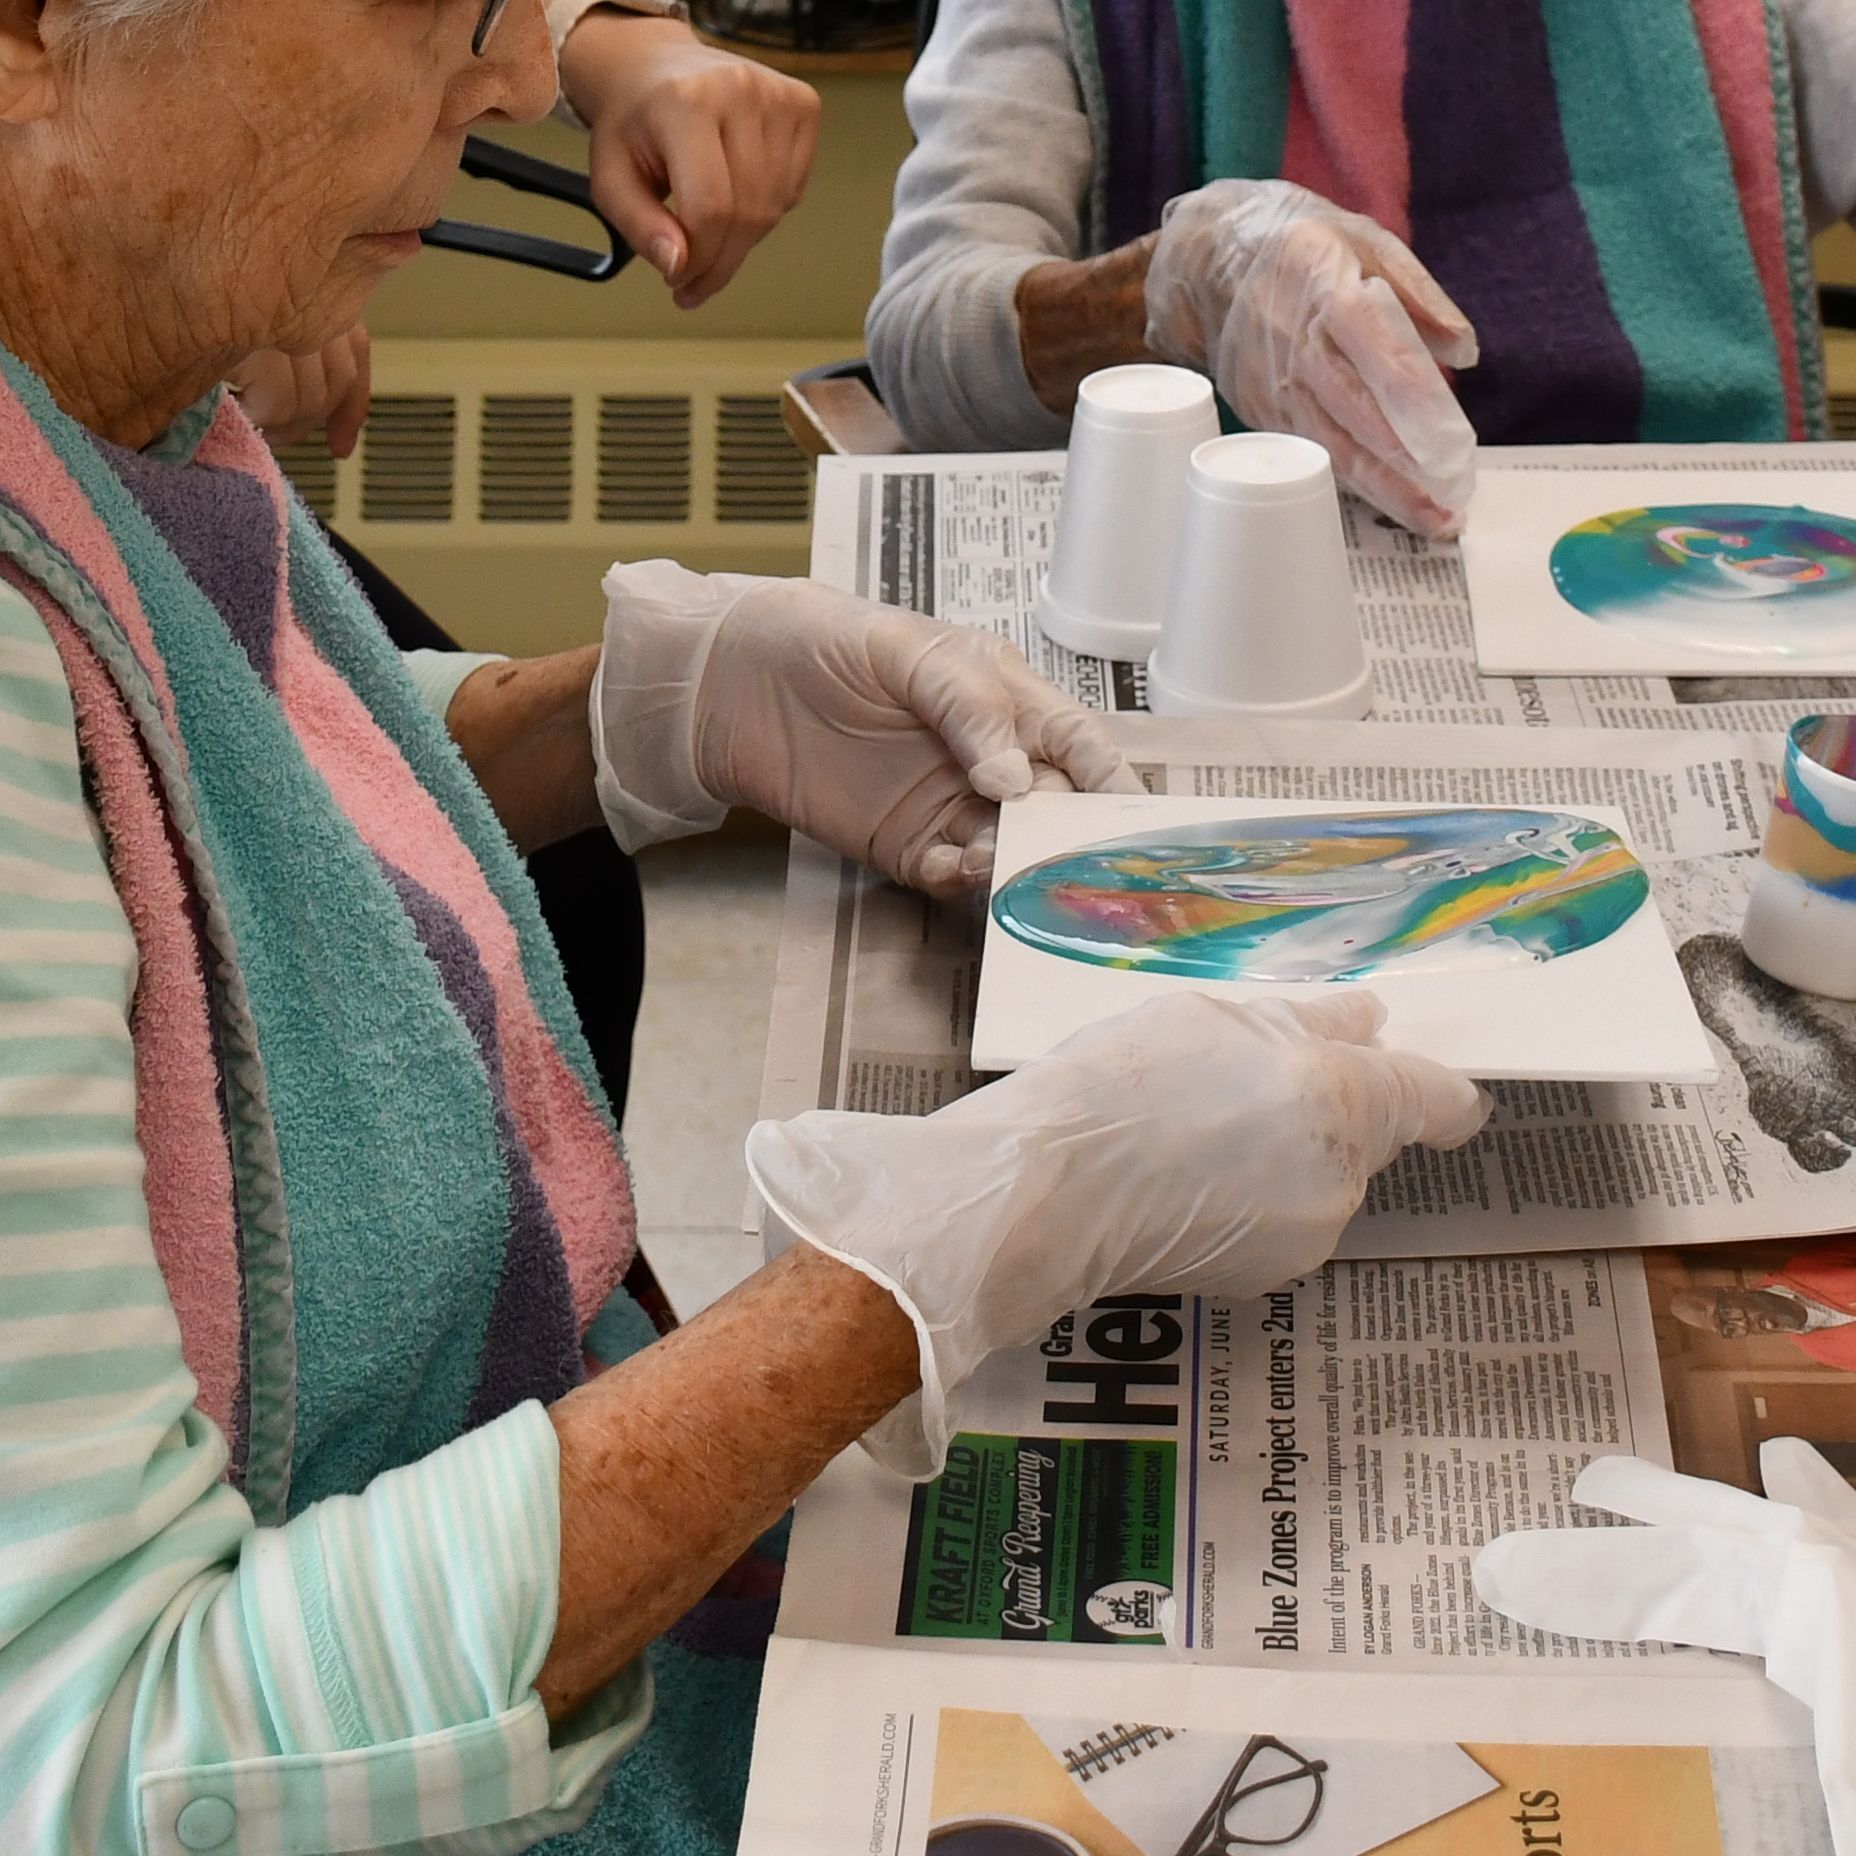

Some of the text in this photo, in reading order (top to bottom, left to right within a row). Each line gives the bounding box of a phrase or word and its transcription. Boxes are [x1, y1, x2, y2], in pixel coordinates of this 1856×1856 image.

[1321, 1303, 1340, 1318] for
[1321, 1320, 1341, 1338] life
[1321, 1340, 1341, 1352] of
[1208, 1307, 1231, 1463] SATURDAY, JUNE
[1322, 1354, 1342, 1392] quality
[1322, 1394, 1343, 1432] overall
[1255, 1290, 1309, 1652] Blue Zones Project enters 2nd
[1323, 1434, 1344, 1486] improve
[1141, 1449, 1166, 1571] FREE ADMISSION!
[1324, 1488, 1344, 1501] to
[1325, 1503, 1345, 1516] is
[925, 1446, 981, 1625] KRAFT FIELD
[980, 1449, 1006, 1611] OXFORD SPORTS COMPLEX
[1001, 1448, 1056, 1631] Grand Reopening
[1325, 1518, 1346, 1573] program
[1201, 1541, 1216, 1650] GRANDFORKSHERALD.COM
[1326, 1575, 1347, 1598] the
[1326, 1600, 1347, 1614] of
[1359, 1562, 1373, 1611] ANDERSON
[1327, 1616, 1348, 1653] Intent
[1361, 1611, 1375, 1643] LOGAN
[1409, 1583, 1425, 1648] GRAND FORKS
